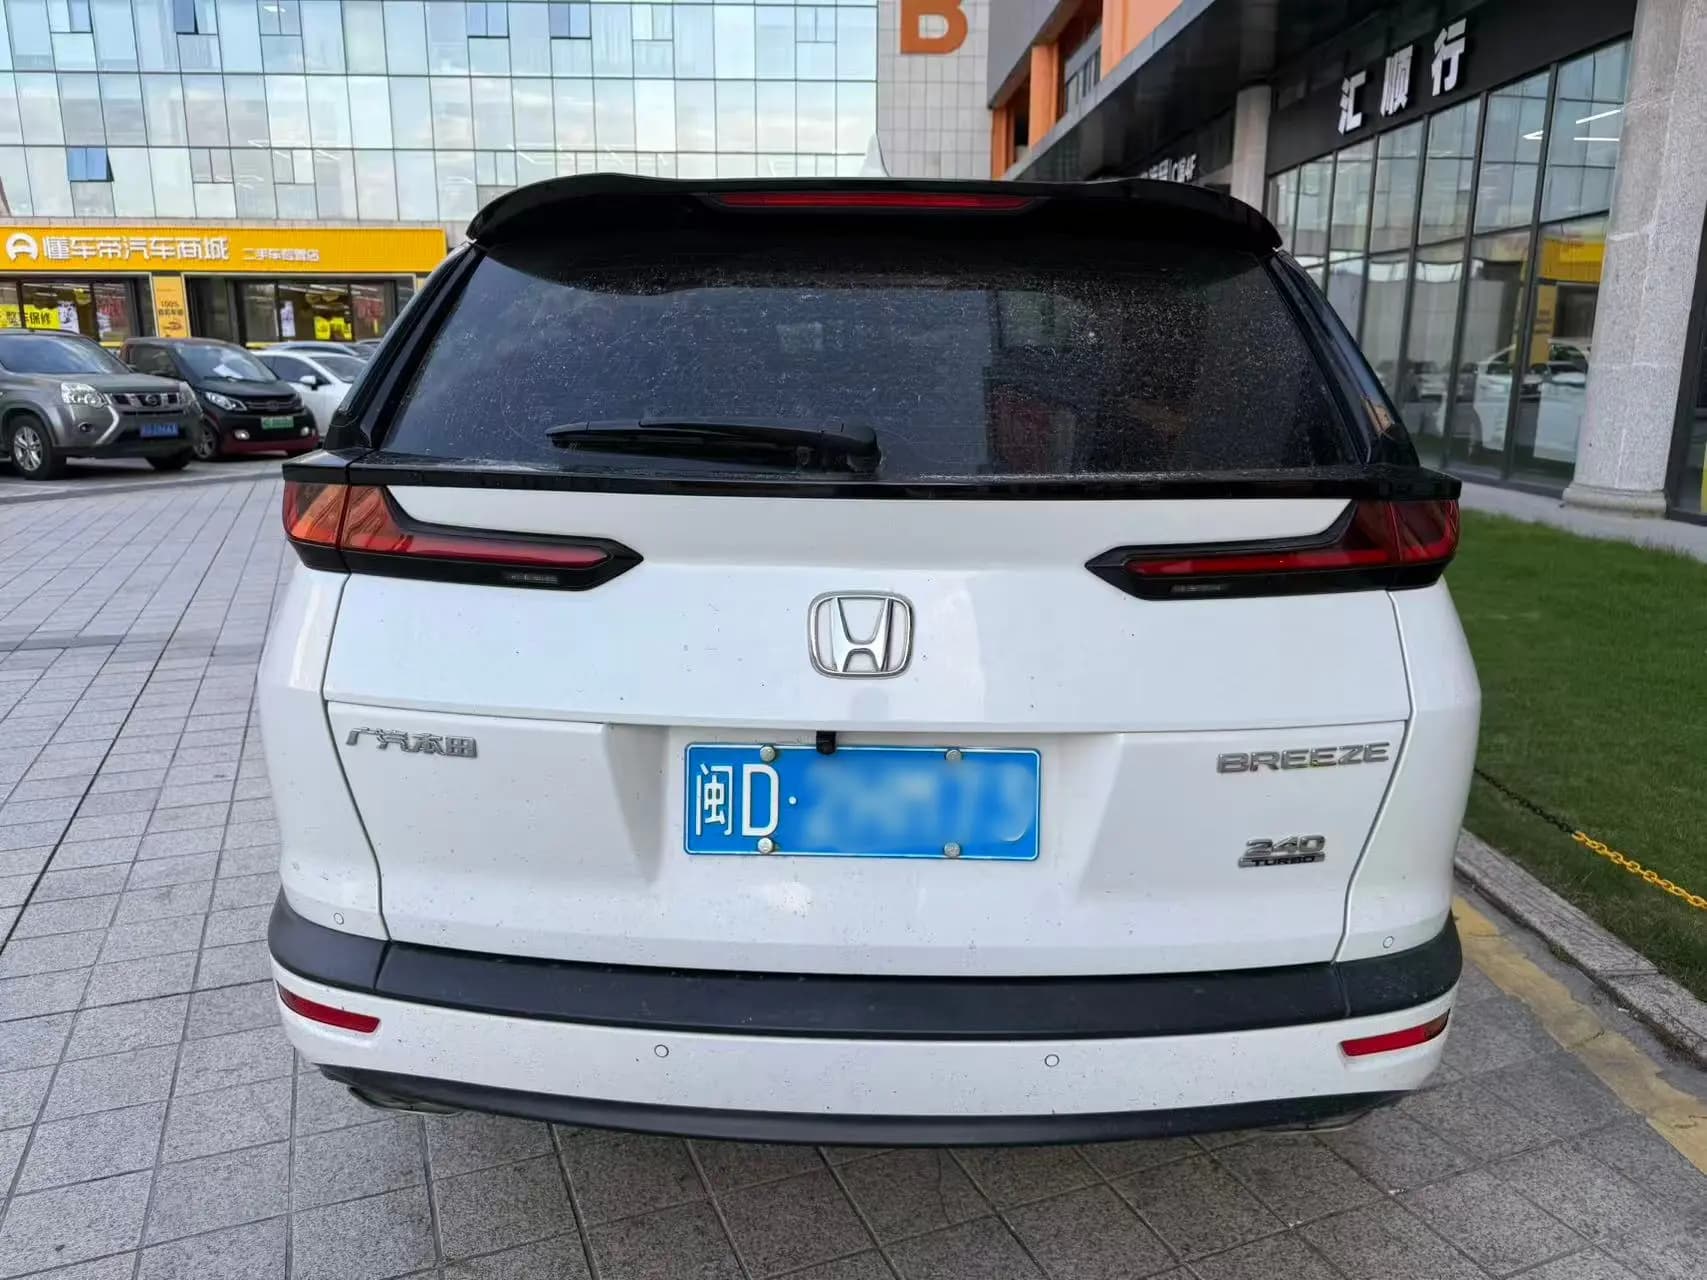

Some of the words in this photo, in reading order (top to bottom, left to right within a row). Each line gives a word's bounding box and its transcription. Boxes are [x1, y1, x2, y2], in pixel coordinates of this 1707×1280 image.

[1338, 18, 1467, 136] 汇顺行
[43, 236, 229, 260] 懂车帝汽车商城
[346, 727, 478, 758] 广汽本田
[1216, 741, 1390, 773] BREEZE
[1243, 834, 1326, 857] 240
